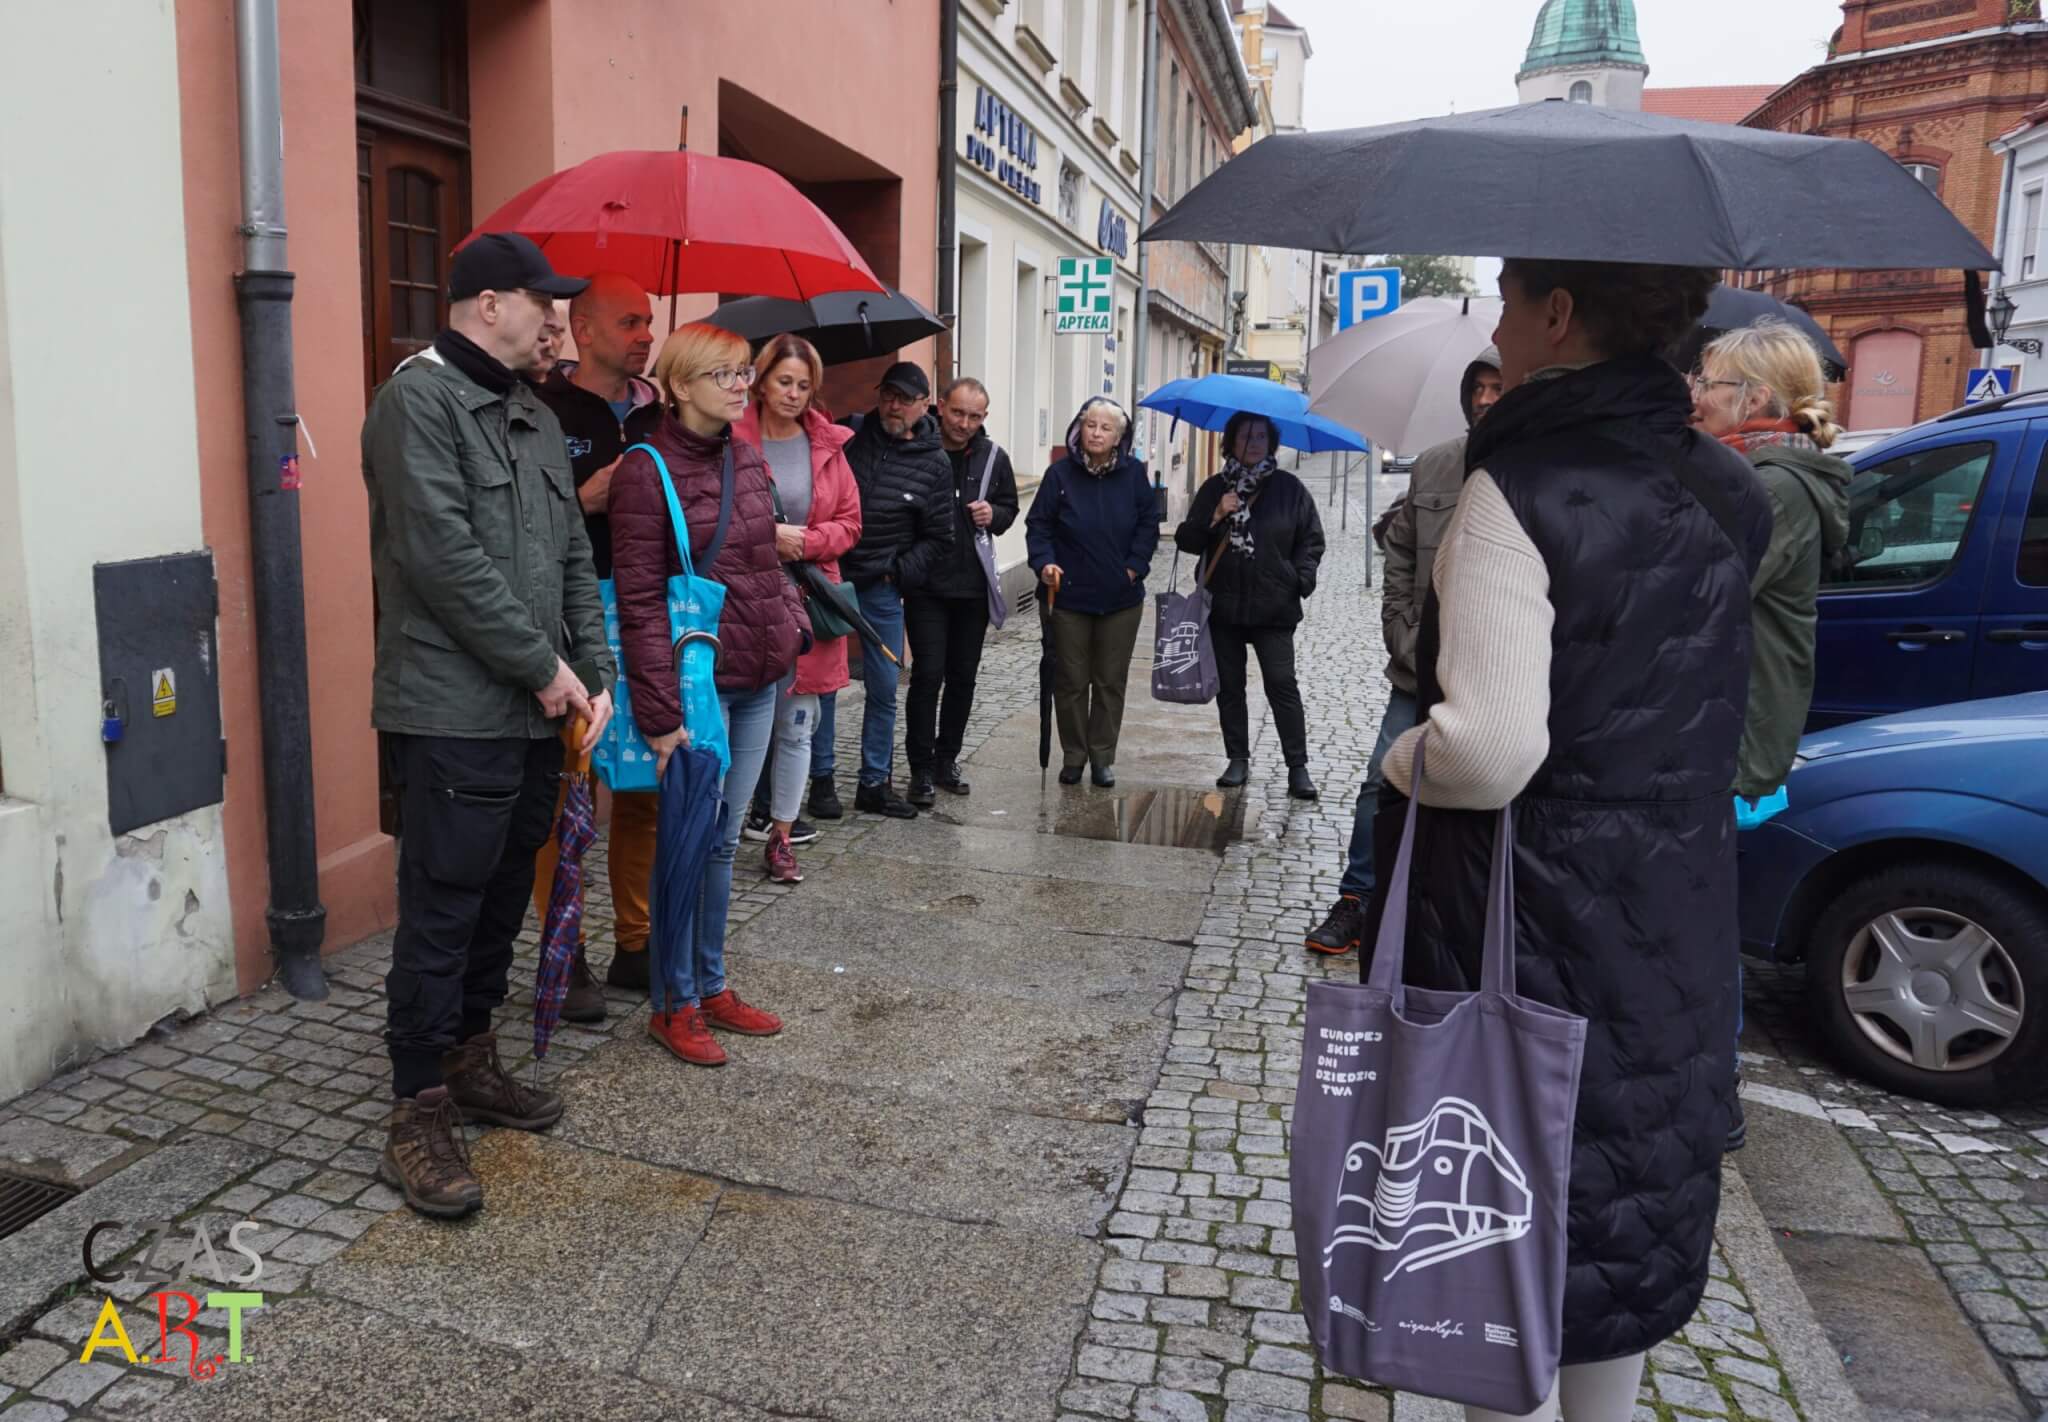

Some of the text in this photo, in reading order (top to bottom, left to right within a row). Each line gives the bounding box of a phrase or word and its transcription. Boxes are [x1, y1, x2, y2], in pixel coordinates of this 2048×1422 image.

[974, 86, 1038, 171] APTEKA
[966, 134, 996, 172] POD
[1352, 275, 1388, 325] P
[1057, 315, 1109, 330] APTEKA
[1320, 1027, 1383, 1042] EUROPEJ
[1327, 1043, 1360, 1056] SKIE
[1317, 1055, 1338, 1069] DNI
[1315, 1069, 1377, 1083] DZIEDZIC
[1321, 1084, 1353, 1097] TWA
